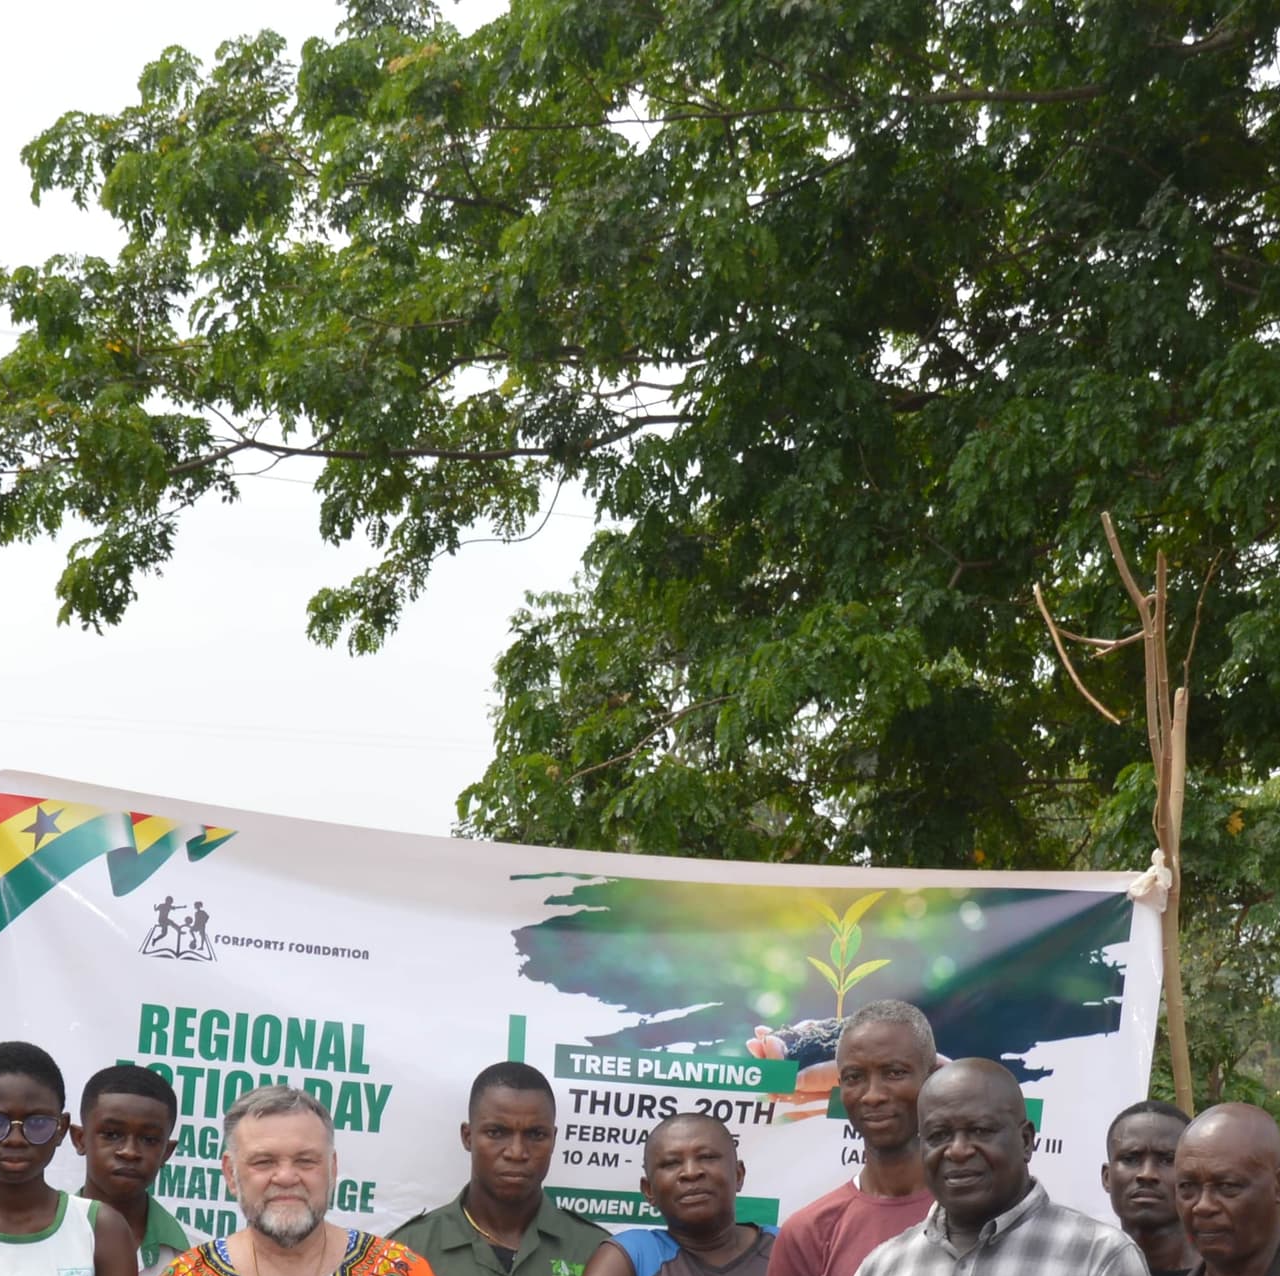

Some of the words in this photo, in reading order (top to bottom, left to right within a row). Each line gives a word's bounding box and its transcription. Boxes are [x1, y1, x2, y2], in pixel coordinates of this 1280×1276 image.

[214, 934, 285, 951] FORSPORTS
[288, 942, 370, 960] FOUNDATION
[138, 1003, 370, 1075] REGIONAL
[570, 1053, 631, 1076] TREE
[638, 1059, 762, 1087] PLANTING
[694, 1098, 775, 1125] 20TH
[565, 1124, 649, 1145] FEBRUA
[562, 1150, 583, 1165] 10
[587, 1152, 619, 1168] AM
[556, 1196, 633, 1216] WOMEN
[175, 1207, 237, 1238] AND
